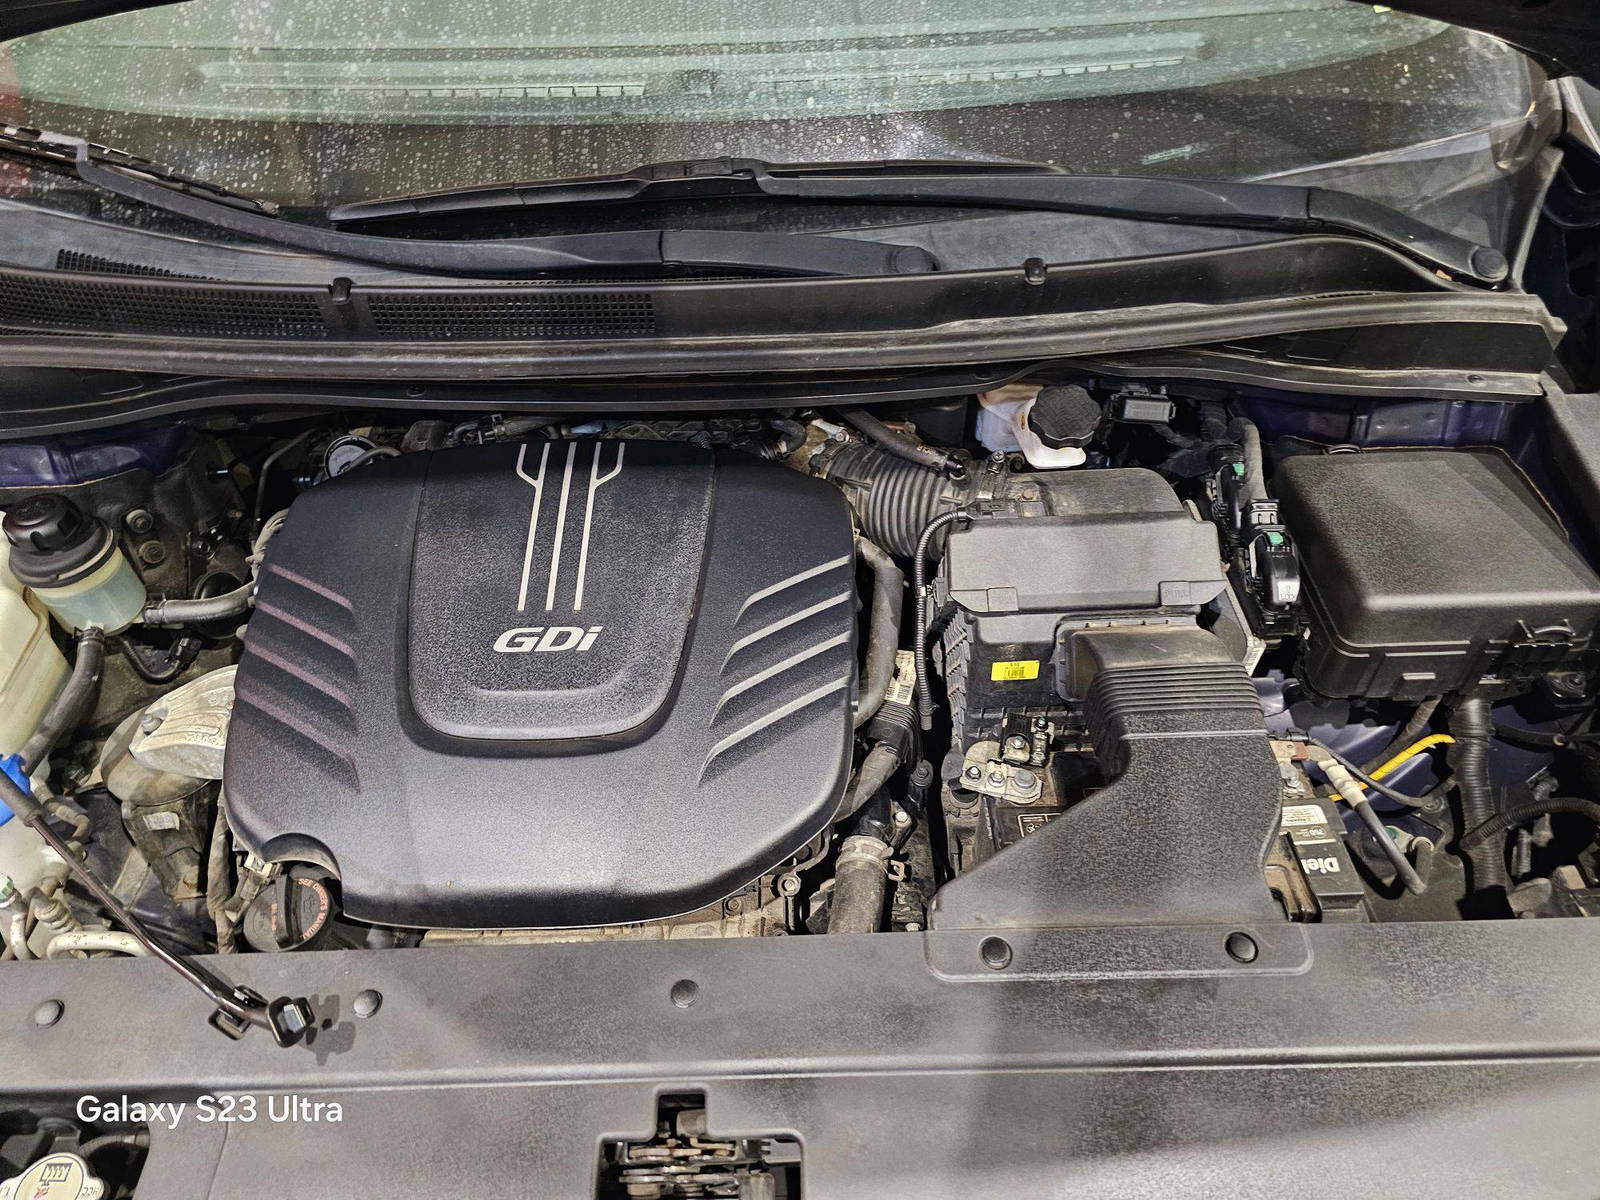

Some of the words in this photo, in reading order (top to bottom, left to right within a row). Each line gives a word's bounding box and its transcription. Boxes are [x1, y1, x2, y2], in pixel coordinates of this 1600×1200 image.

[493, 626, 603, 652] GDi
[297, 878, 313, 887] SEE
[301, 912, 326, 940] MANUAL
